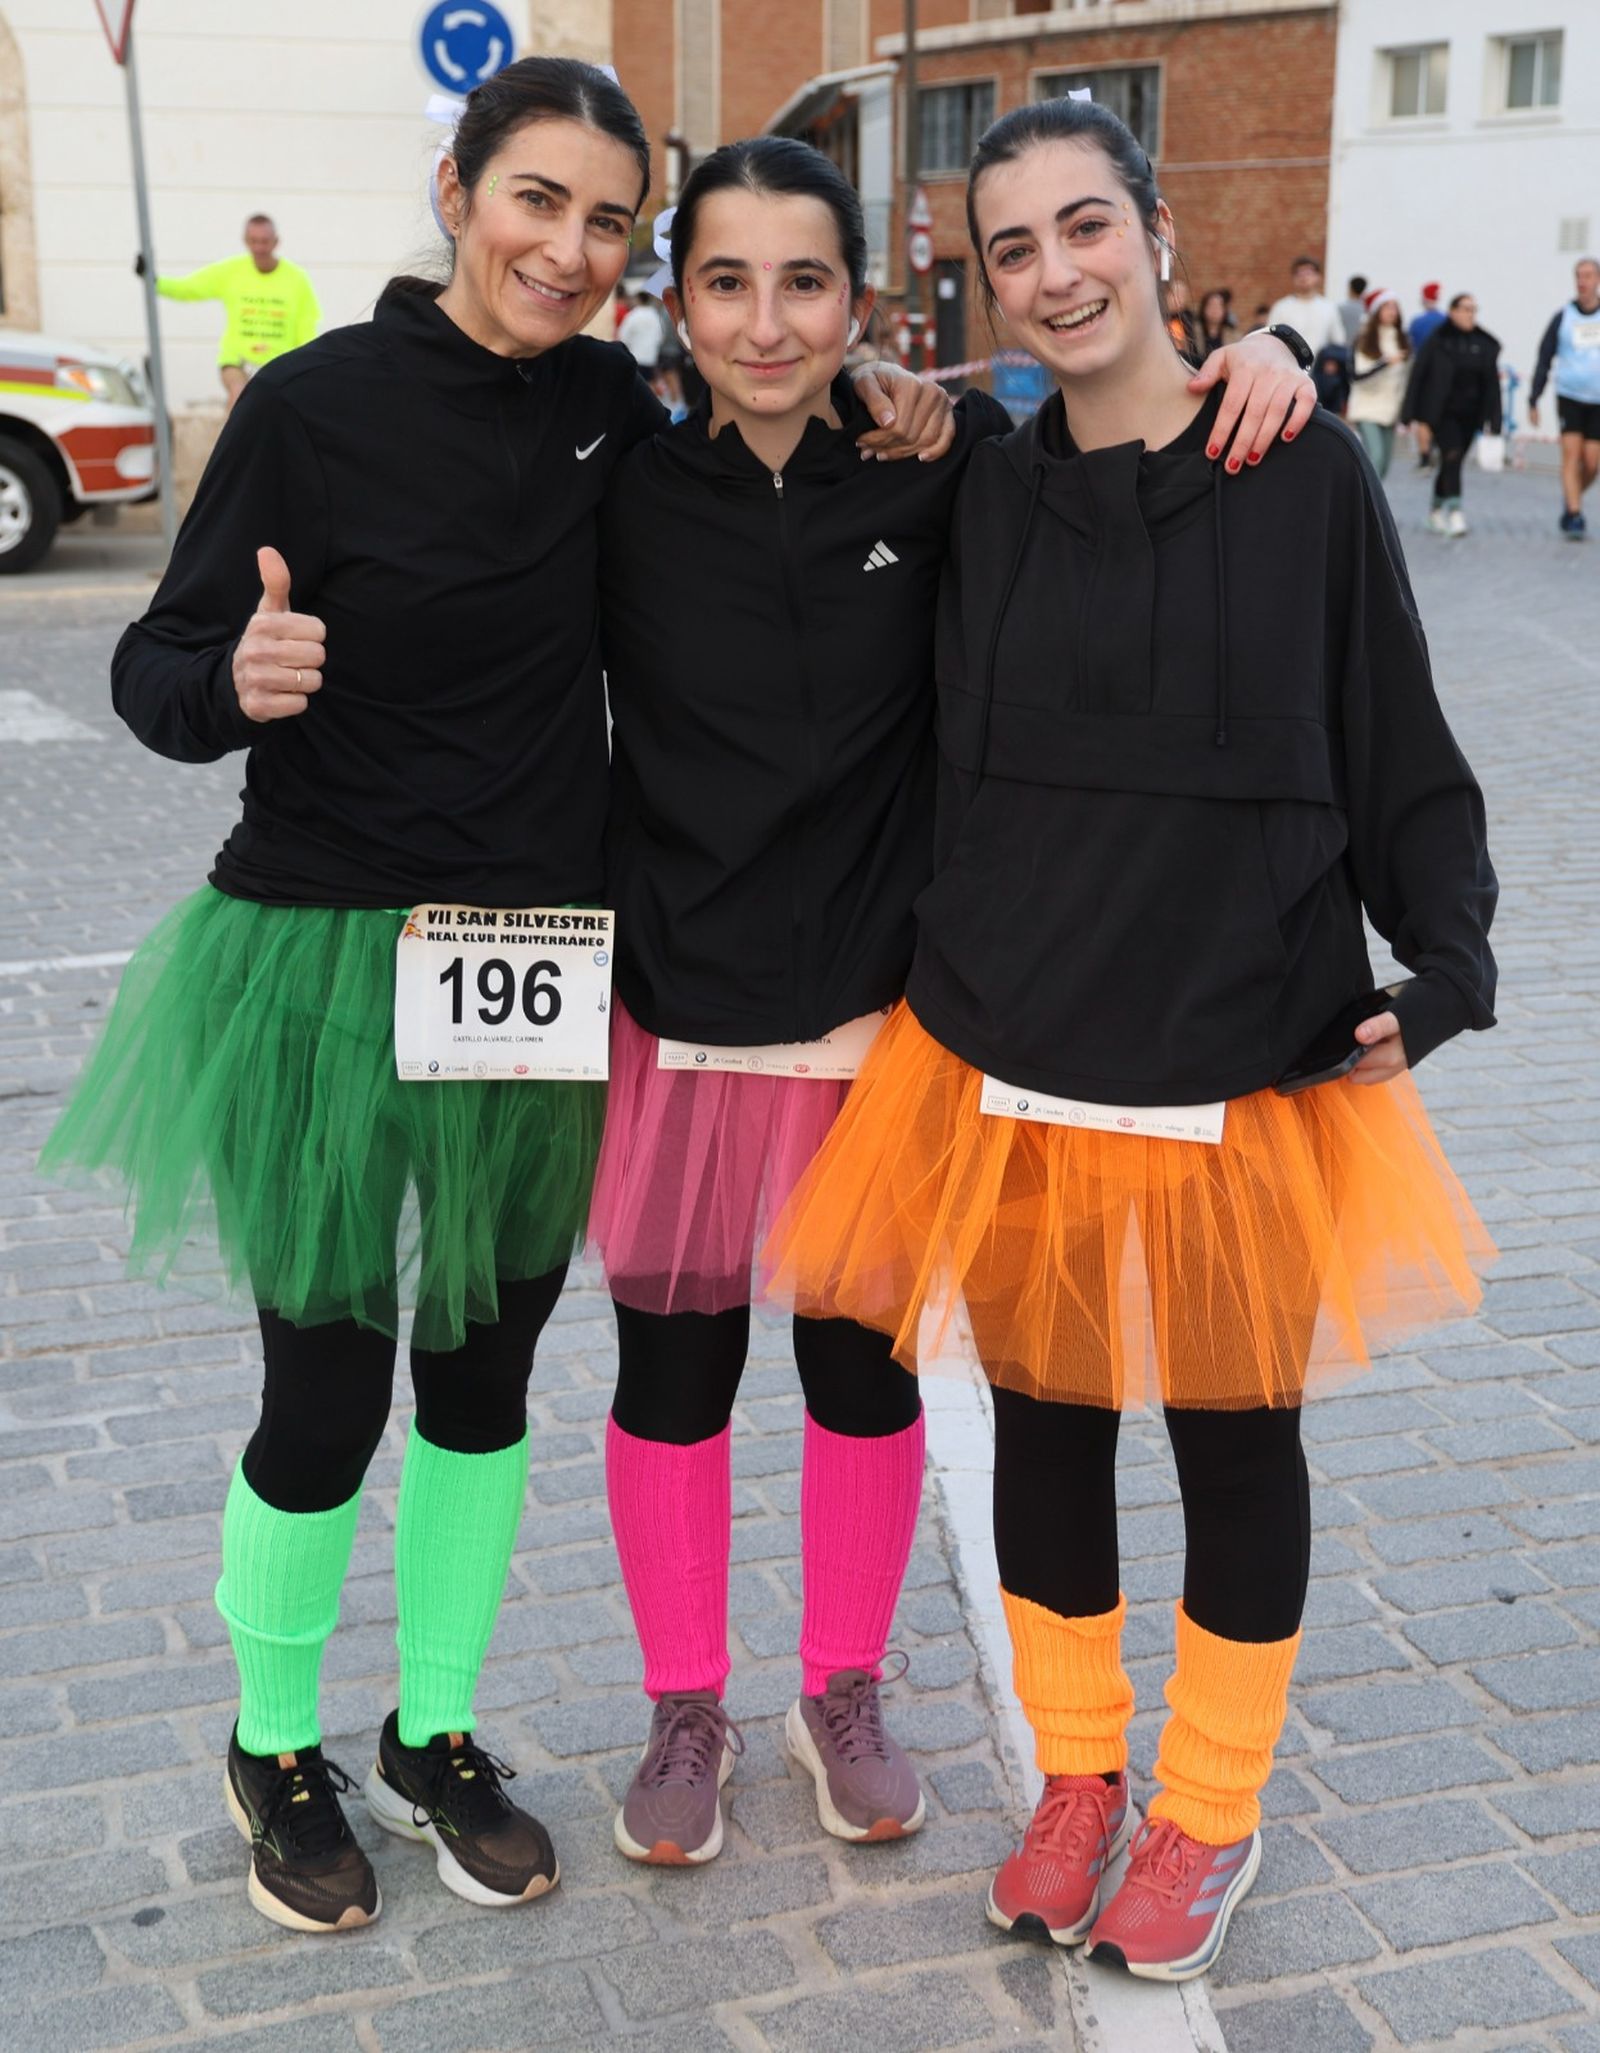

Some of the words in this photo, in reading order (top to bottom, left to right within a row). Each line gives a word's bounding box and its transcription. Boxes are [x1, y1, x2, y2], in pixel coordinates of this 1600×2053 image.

[427, 910, 451, 925] VII
[456, 910, 498, 927] SAN
[503, 912, 609, 931] SILVESTRE
[427, 931, 459, 942] REAL
[462, 932, 496, 943] CLUB
[500, 933, 605, 947] MEDITERRÁNEO
[439, 957, 562, 1026] 196
